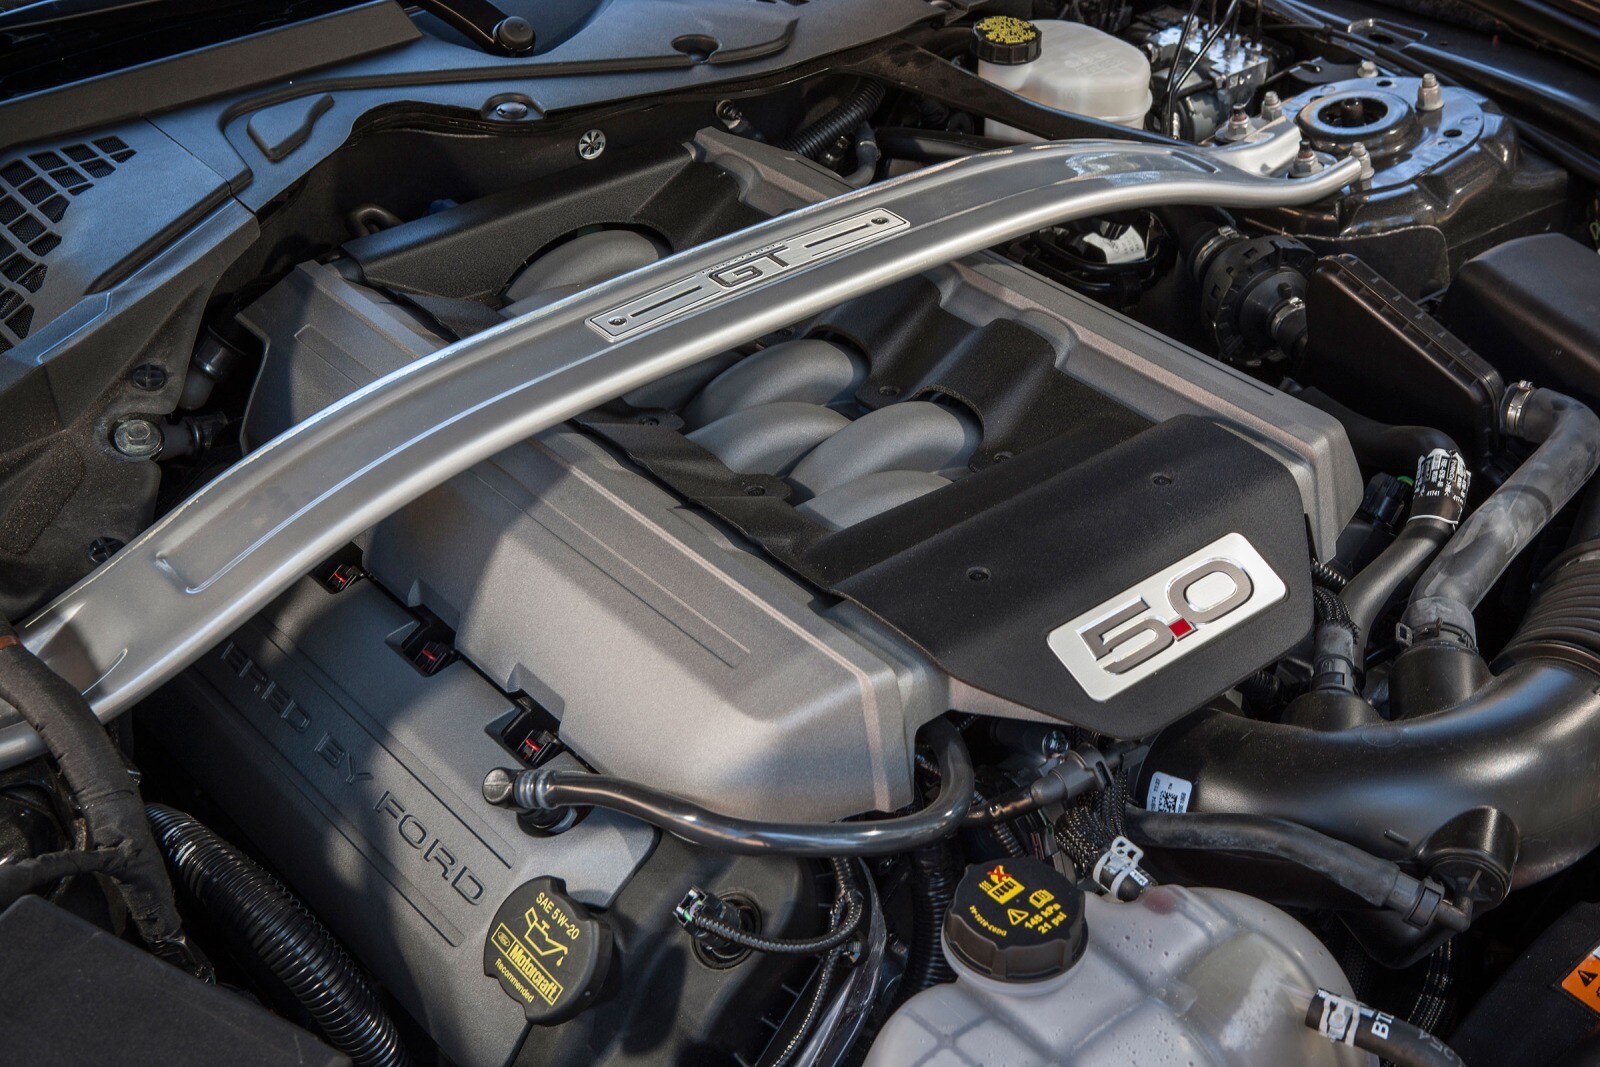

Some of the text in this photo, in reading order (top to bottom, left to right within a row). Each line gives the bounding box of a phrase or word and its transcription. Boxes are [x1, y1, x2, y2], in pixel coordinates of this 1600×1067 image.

[708, 244, 790, 289] GT
[1075, 556, 1255, 676] 5.0
[220, 641, 487, 906] ERED BY FORD
[535, 891, 580, 941] SAE 5W-20
[1024, 903, 1062, 930] 145 kPa
[1037, 922, 1053, 935] 21
[494, 958, 535, 1004] Recommended
[508, 943, 559, 1000] Motorcraft
